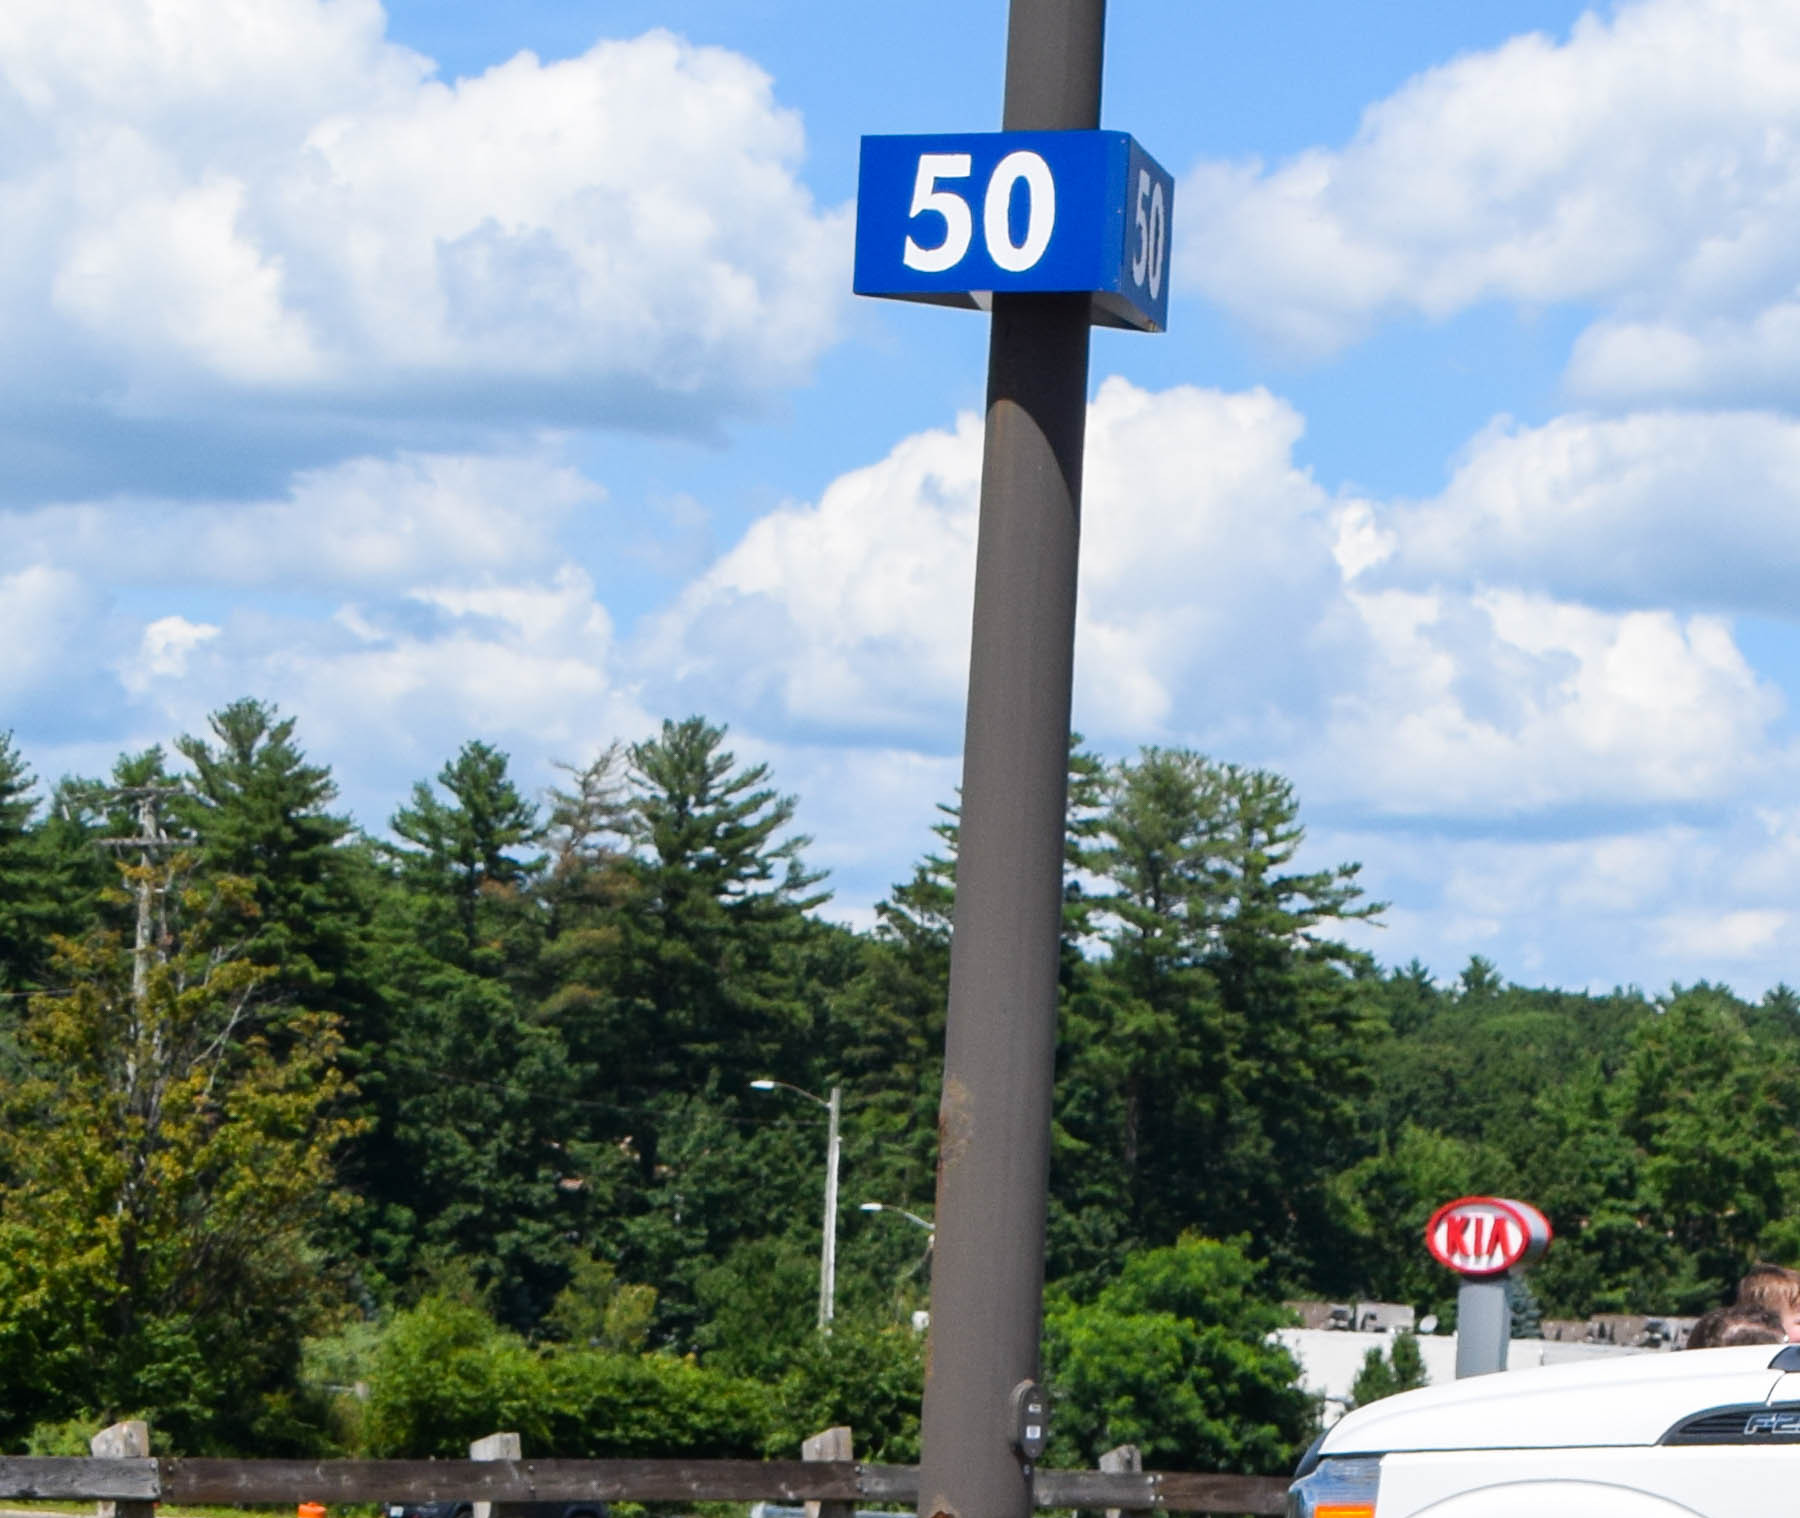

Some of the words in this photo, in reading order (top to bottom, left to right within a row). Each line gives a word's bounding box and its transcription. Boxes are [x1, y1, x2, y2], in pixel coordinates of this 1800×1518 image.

[903, 150, 1056, 273] 50
[1132, 169, 1165, 300] 50
[1446, 1216, 1511, 1257] KIA
